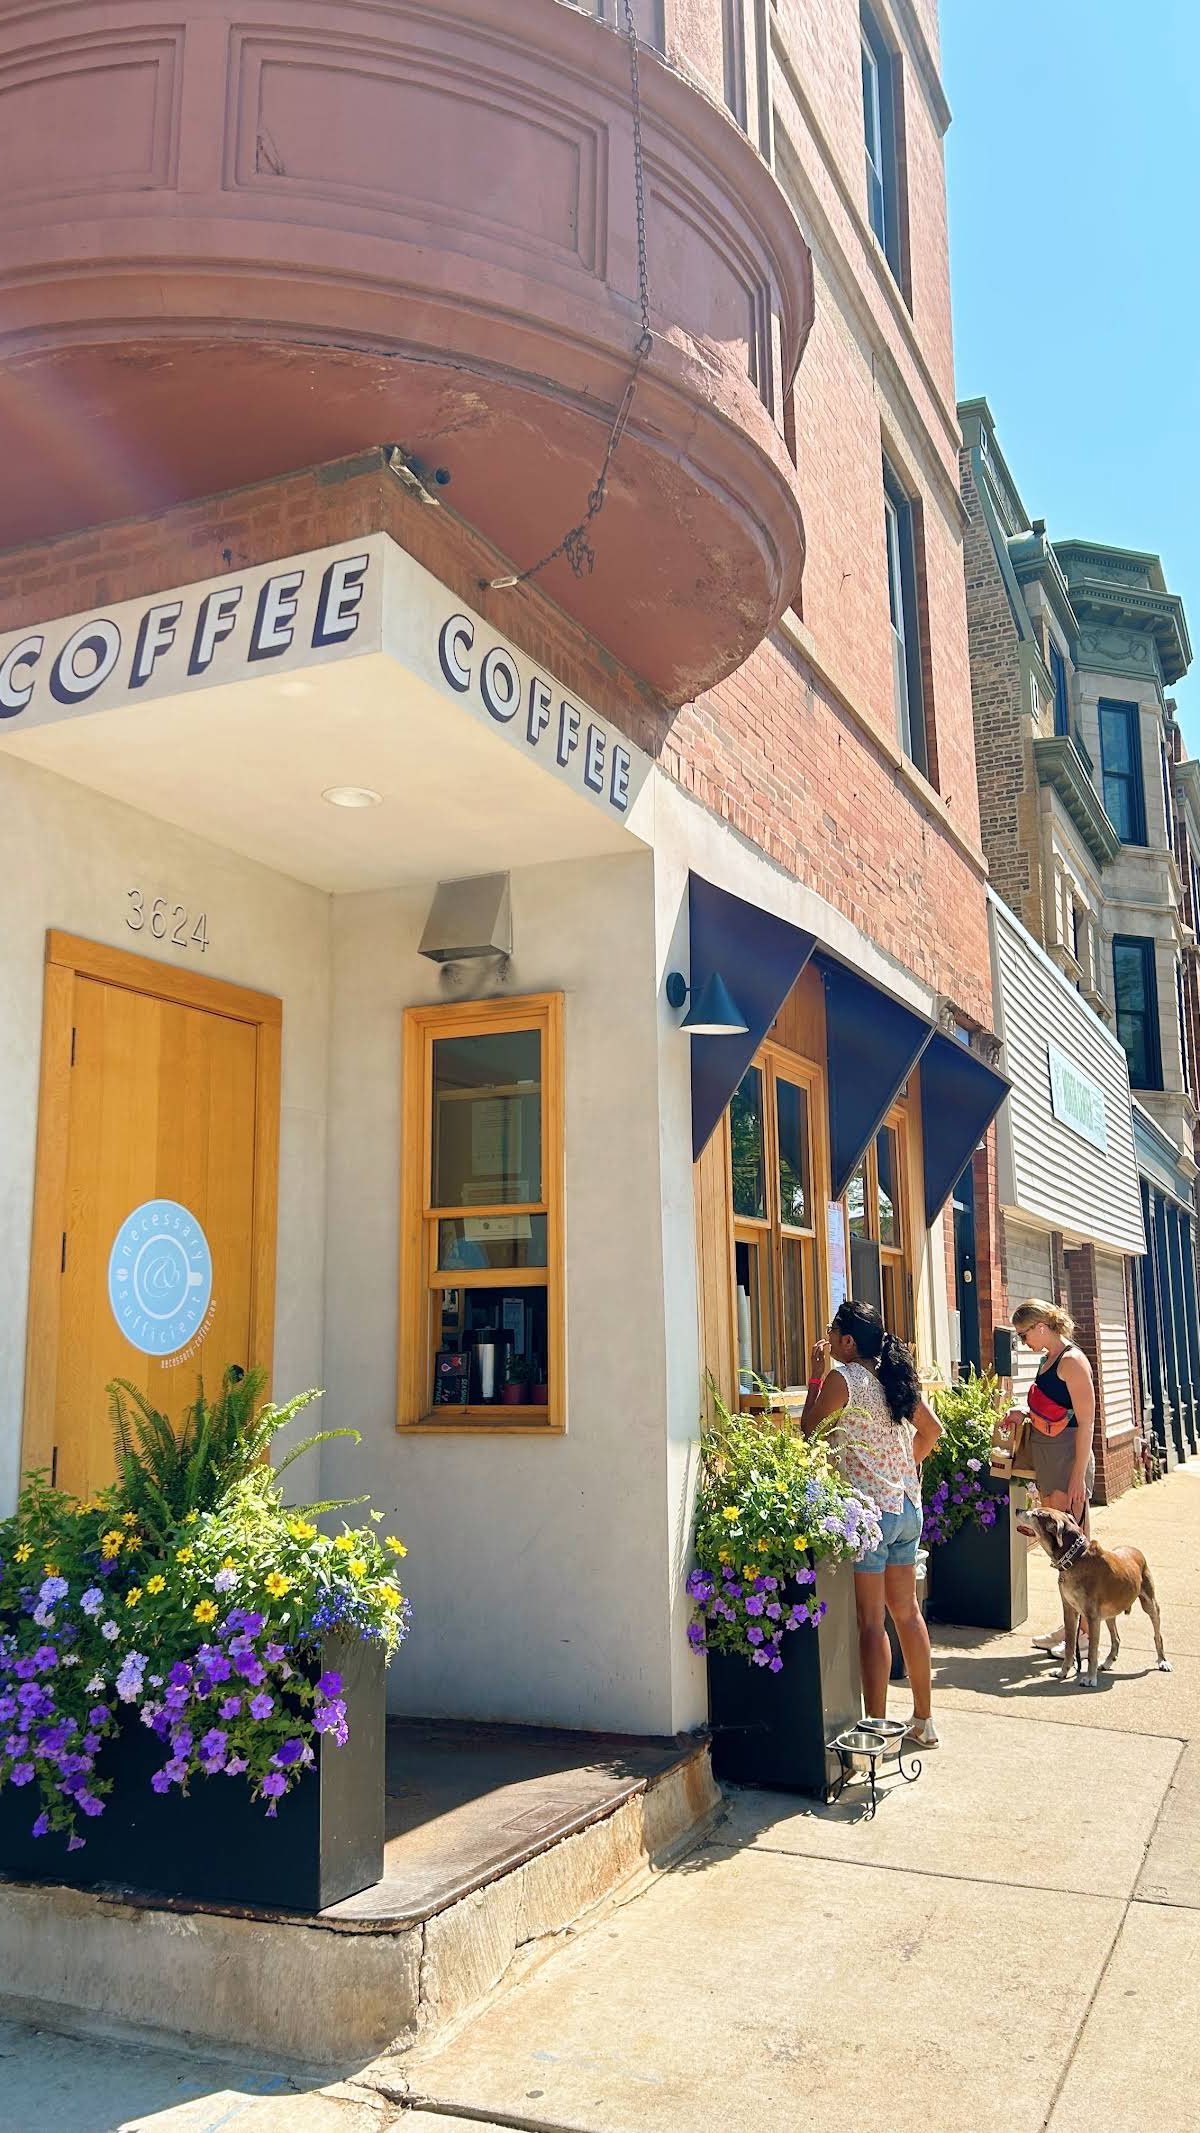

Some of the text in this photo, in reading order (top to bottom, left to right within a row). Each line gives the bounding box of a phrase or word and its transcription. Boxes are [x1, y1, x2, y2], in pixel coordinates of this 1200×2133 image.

[0, 554, 370, 719] COFFEE
[438, 613, 631, 813] COFFEE
[126, 889, 209, 952] 3624
[122, 1213, 203, 1260] necessary
[120, 1290, 201, 1343] sufficient
